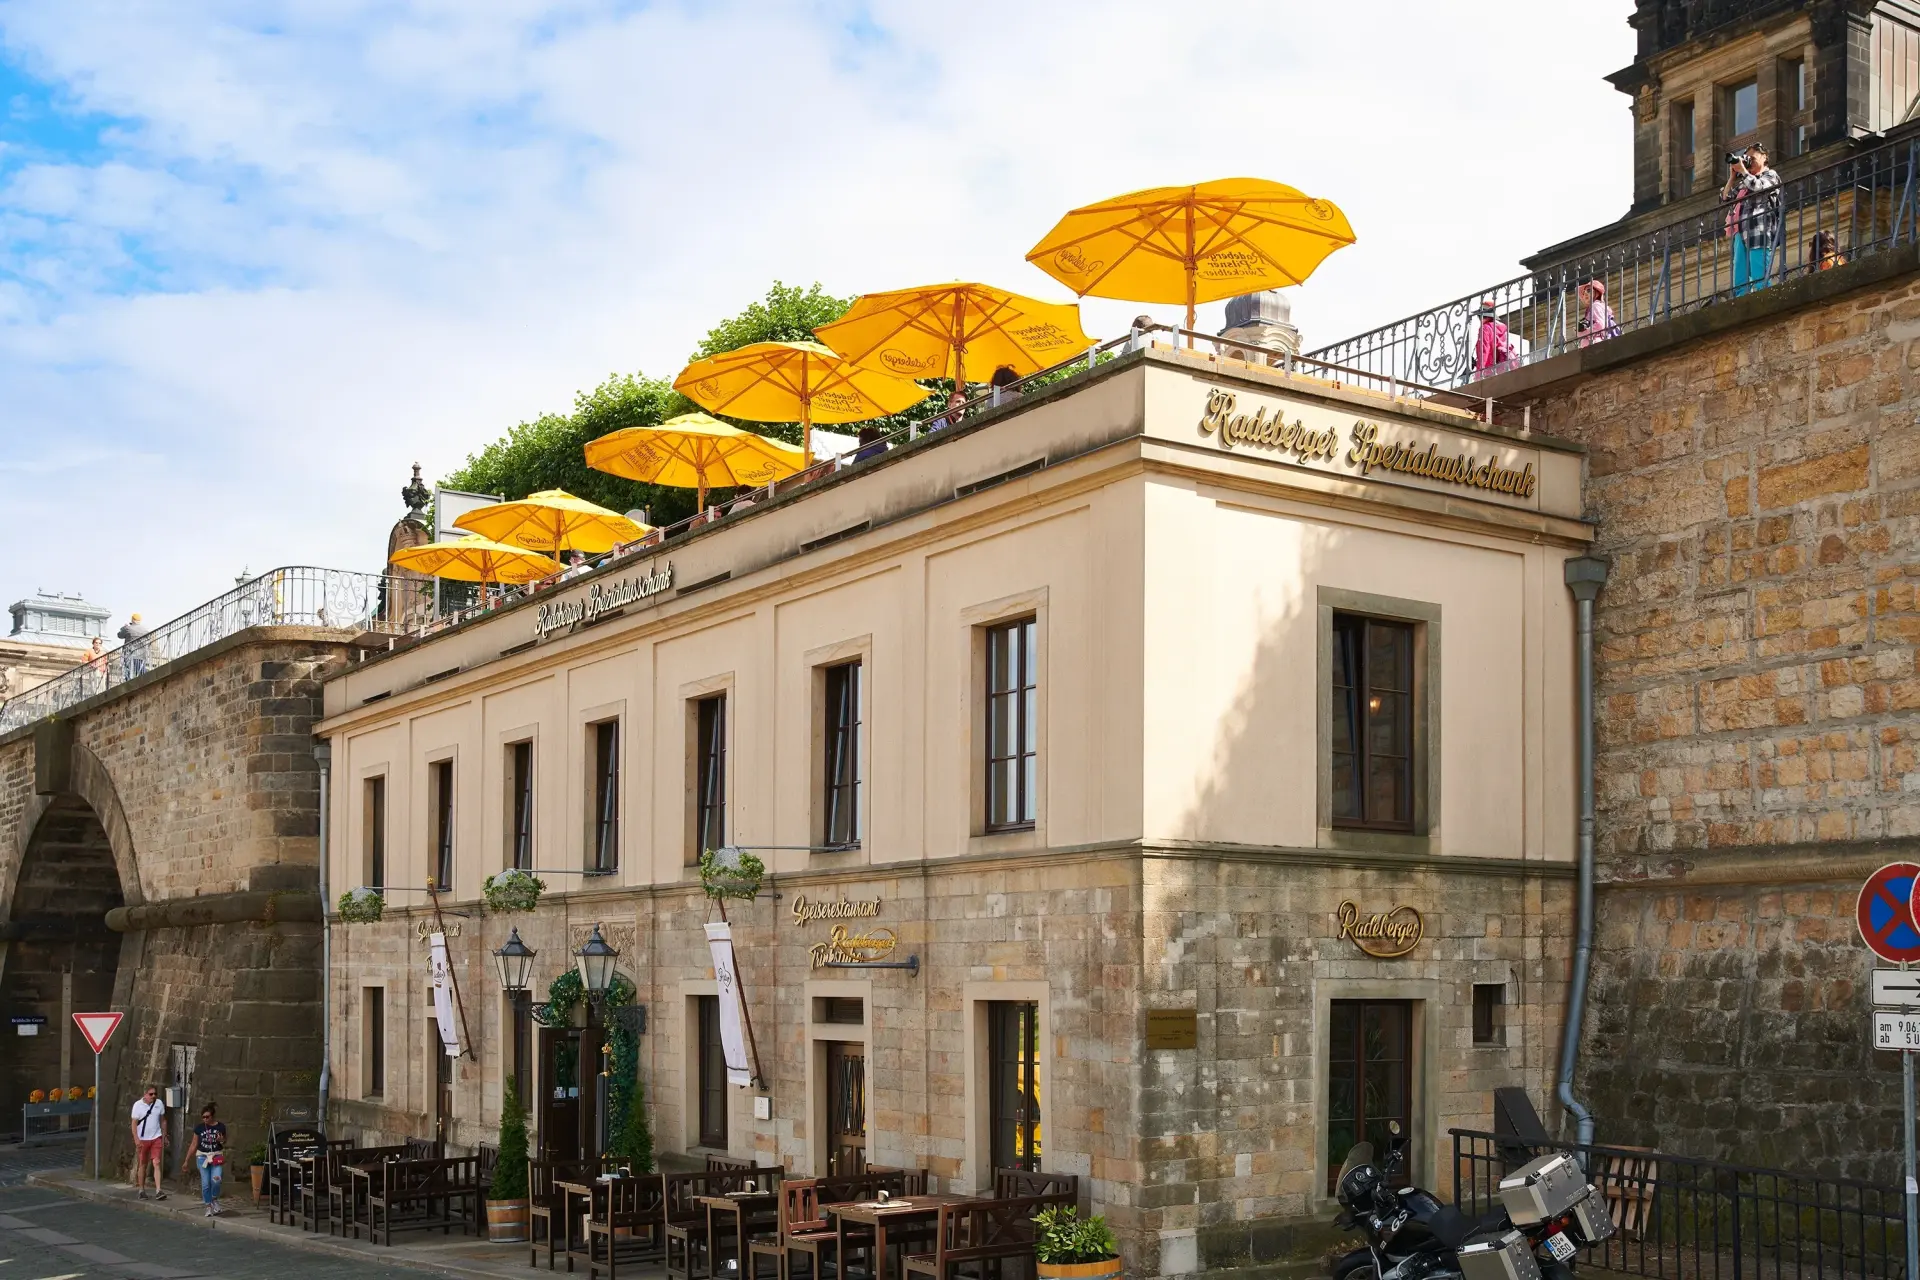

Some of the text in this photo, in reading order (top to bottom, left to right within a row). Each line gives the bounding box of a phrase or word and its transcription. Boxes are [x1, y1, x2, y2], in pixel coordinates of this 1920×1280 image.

[1203, 388, 1535, 497] Radeberger Spezialausschank
[535, 561, 673, 638] Radeberger Spezialausschank
[792, 895, 880, 927] Speiserestaurant
[1338, 900, 1424, 957] Radeberger
[1880, 1021, 1920, 1033] am 9.06.
[1880, 1033, 1890, 1043] ab
[1906, 1033, 1911, 1044] 5
[1391, 1209, 1408, 1232] GS
